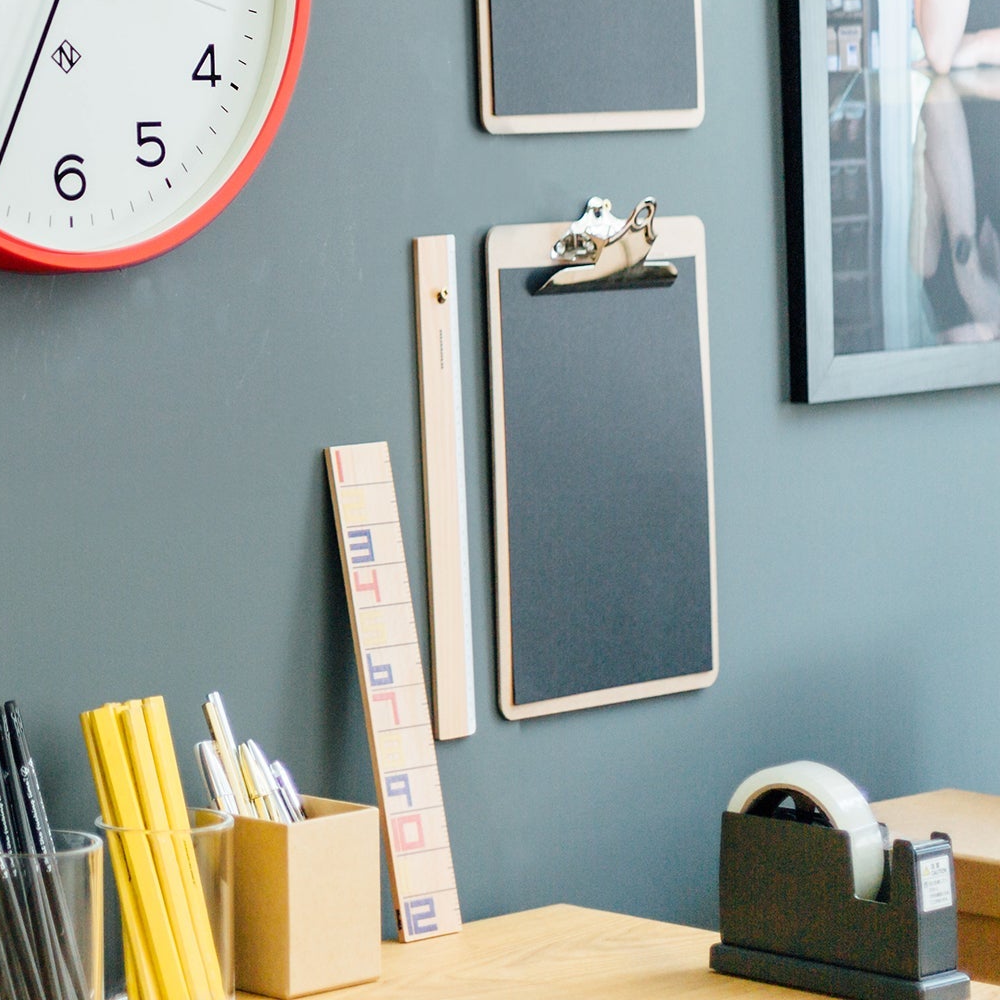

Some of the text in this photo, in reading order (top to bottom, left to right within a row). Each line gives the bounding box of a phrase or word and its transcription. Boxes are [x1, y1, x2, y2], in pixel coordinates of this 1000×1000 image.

[192, 44, 222, 87] 4
[136, 122, 165, 167] 5
[54, 154, 86, 201] 6
[348, 529, 375, 564] 3
[353, 569, 381, 603] 4
[372, 692, 400, 726] 7
[385, 773, 413, 807] 9
[391, 814, 425, 851] 10
[404, 897, 438, 936] 12
